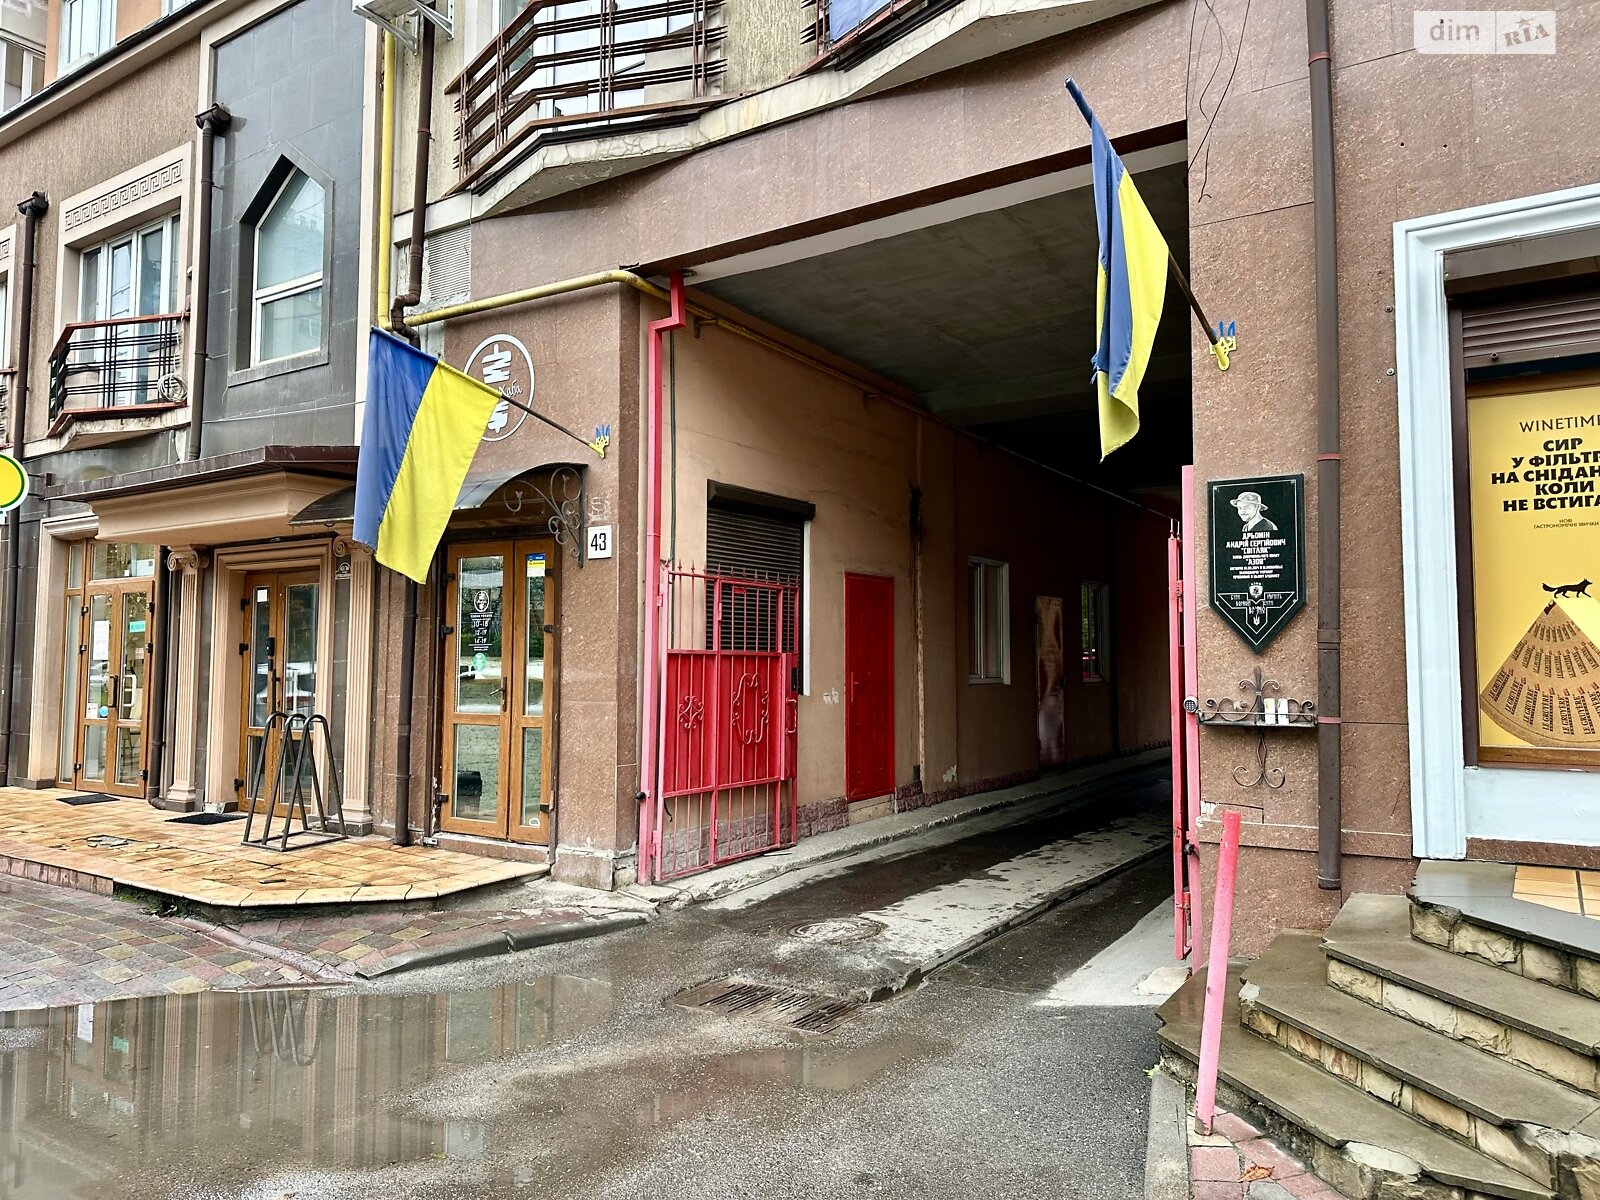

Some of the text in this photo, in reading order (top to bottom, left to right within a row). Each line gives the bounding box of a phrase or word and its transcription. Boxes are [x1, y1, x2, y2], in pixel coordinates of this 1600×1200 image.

[1543, 438, 1583, 452] СИР
[1511, 457, 1525, 469] У
[1491, 466, 1600, 484] НА СНІДАН
[1535, 481, 1594, 496] КОЛИ
[1503, 499, 1528, 512] НЕ
[591, 533, 606, 551] 43
[1226, 538, 1286, 549] АНДРІЙ СЕРГІЙОВИЧ
